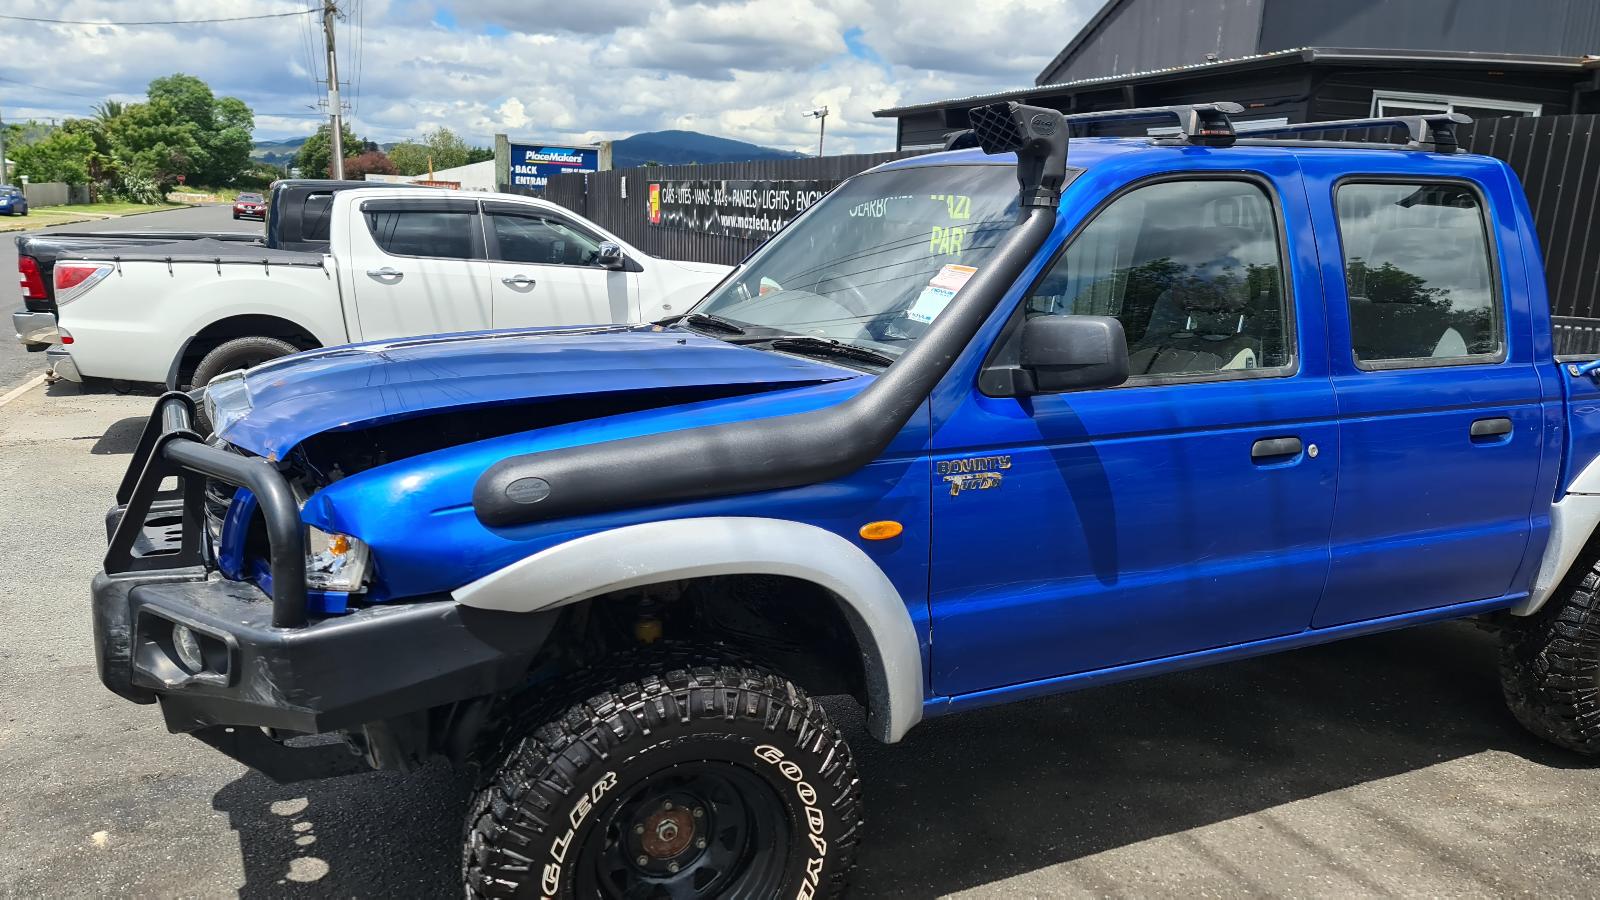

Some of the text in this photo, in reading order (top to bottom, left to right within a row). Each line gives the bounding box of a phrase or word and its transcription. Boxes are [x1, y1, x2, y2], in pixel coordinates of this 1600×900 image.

[525, 150, 583, 163] PlaceMakers
[515, 165, 538, 174] BACK
[662, 187, 675, 204] CARS
[678, 187, 692, 205] UTES
[694, 187, 710, 206] VANS
[732, 188, 757, 209] PANELS
[762, 189, 790, 211] LIGHTS
[937, 456, 1012, 475] BOUNTY
